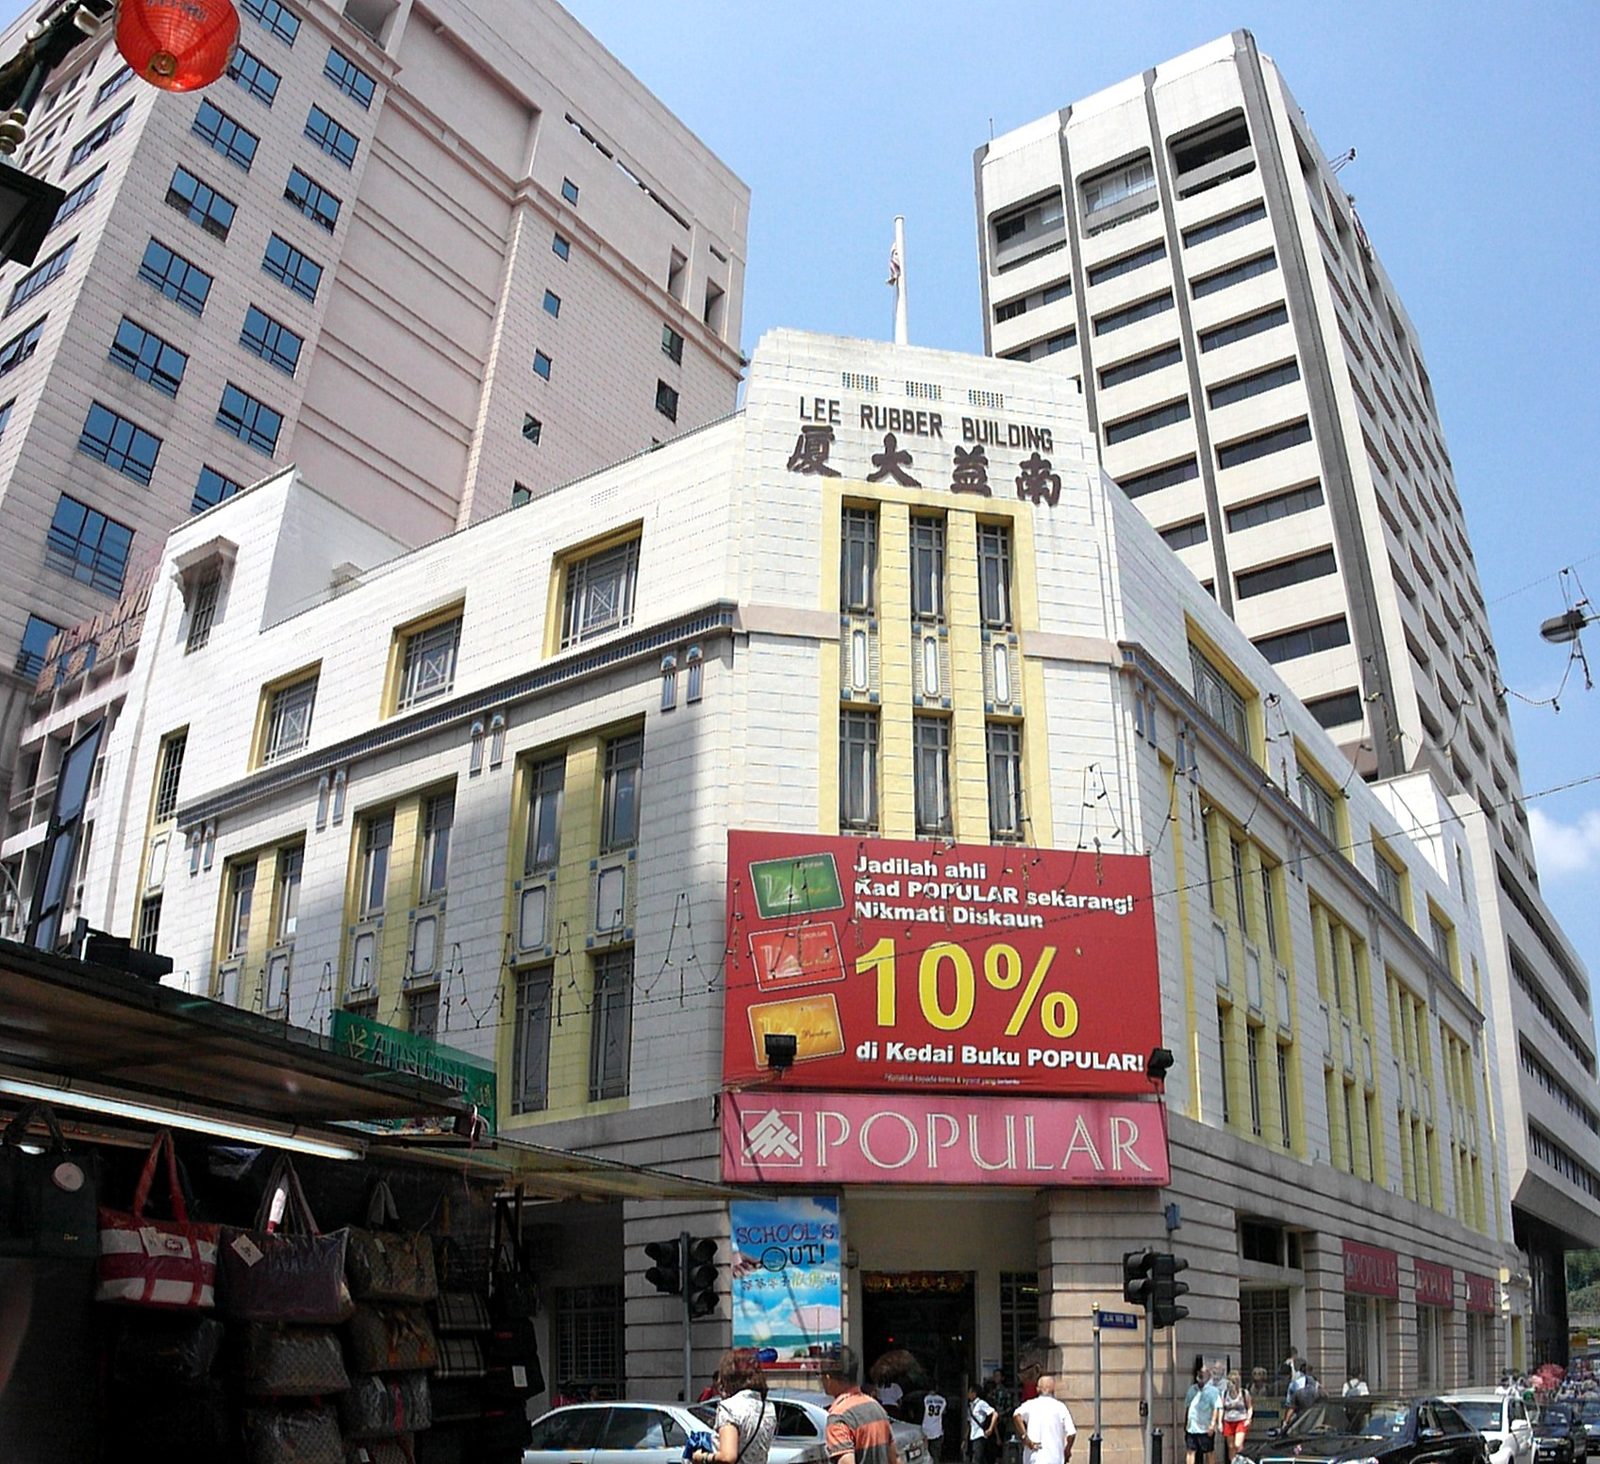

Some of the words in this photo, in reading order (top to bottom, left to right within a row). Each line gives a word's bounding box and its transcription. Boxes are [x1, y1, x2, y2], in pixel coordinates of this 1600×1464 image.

[800, 396, 841, 425] LEE
[860, 404, 943, 439] RUBBER
[961, 416, 1054, 454] BUILDING
[853, 855, 938, 877] Jadilah
[945, 862, 986, 879] ahli
[855, 877, 900, 897] Kad
[908, 881, 1019, 904] POPULAR
[1027, 890, 1133, 914] sekarang!
[855, 901, 945, 922] Nikmati
[953, 906, 1043, 928] Diskaun
[855, 937, 1079, 1038] 10%
[856, 1041, 878, 1060] di
[886, 1042, 953, 1063] Kedai
[961, 1045, 1020, 1066] Buku
[1027, 1049, 1144, 1072] POPULAR!
[815, 1111, 1152, 1172] POPULAR
[760, 1244, 825, 1272] OUT!
